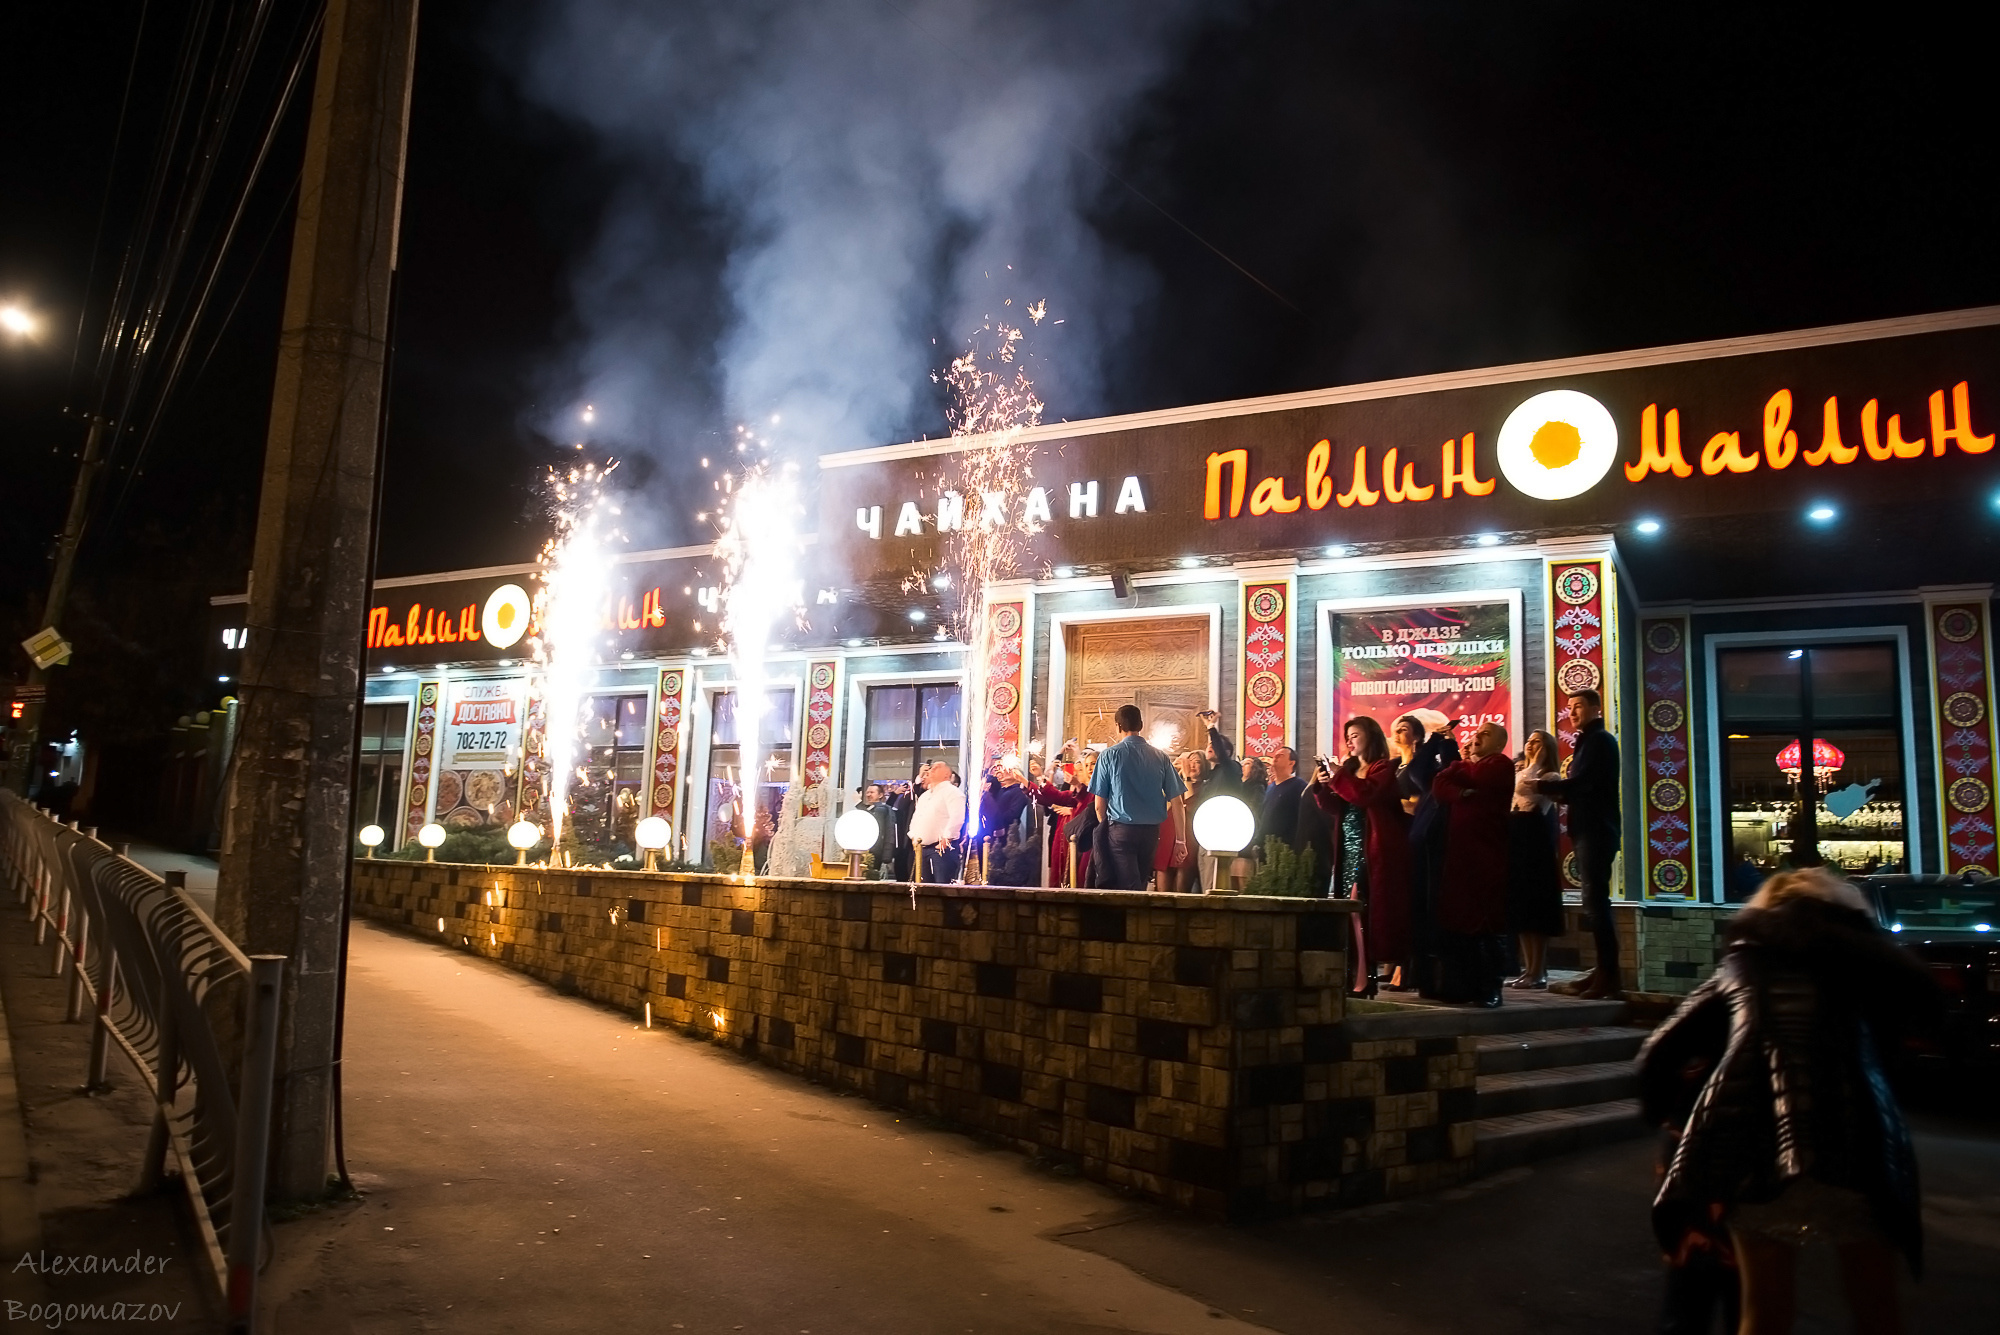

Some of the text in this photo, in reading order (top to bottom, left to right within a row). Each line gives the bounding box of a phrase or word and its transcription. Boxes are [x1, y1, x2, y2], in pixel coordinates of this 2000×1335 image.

[1381, 625, 1461, 643] В ДЖАЗЕ
[1341, 639, 1505, 660] ТОЛЬКО ДЕВУШКИ
[1351, 679, 1429, 696] НОВОГОДНЯЯ
[457, 701, 512, 723] ДОСТАВКИ
[456, 731, 508, 750] 702-72-72
